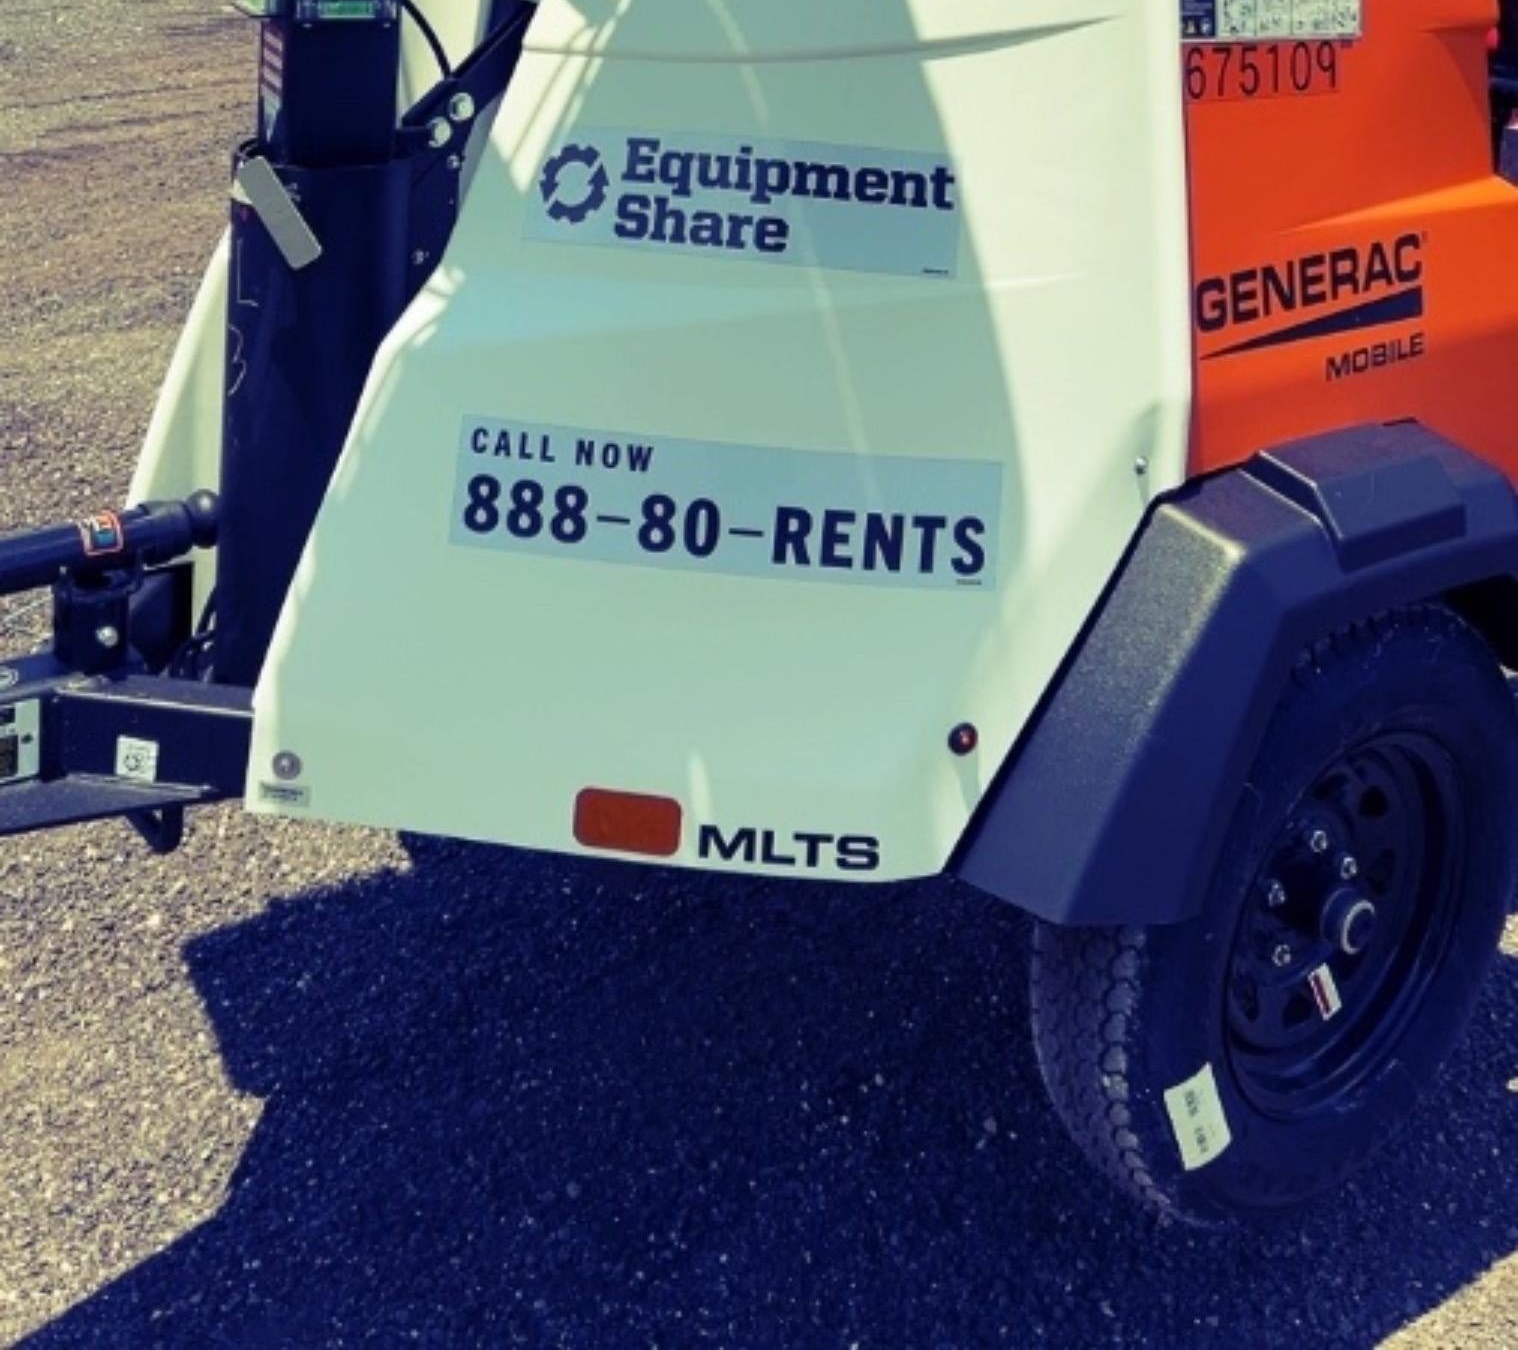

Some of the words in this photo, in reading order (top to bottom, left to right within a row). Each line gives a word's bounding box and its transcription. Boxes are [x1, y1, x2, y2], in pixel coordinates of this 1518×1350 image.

[1186, 39, 1336, 100] 675109
[620, 137, 956, 211] Equipment
[613, 193, 790, 253] Share
[1195, 233, 1423, 333] GENERAC
[1325, 332, 1425, 382] MOBILE
[470, 427, 556, 463] CALL
[575, 438, 655, 473] NOW
[698, 824, 881, 871] MLTS
